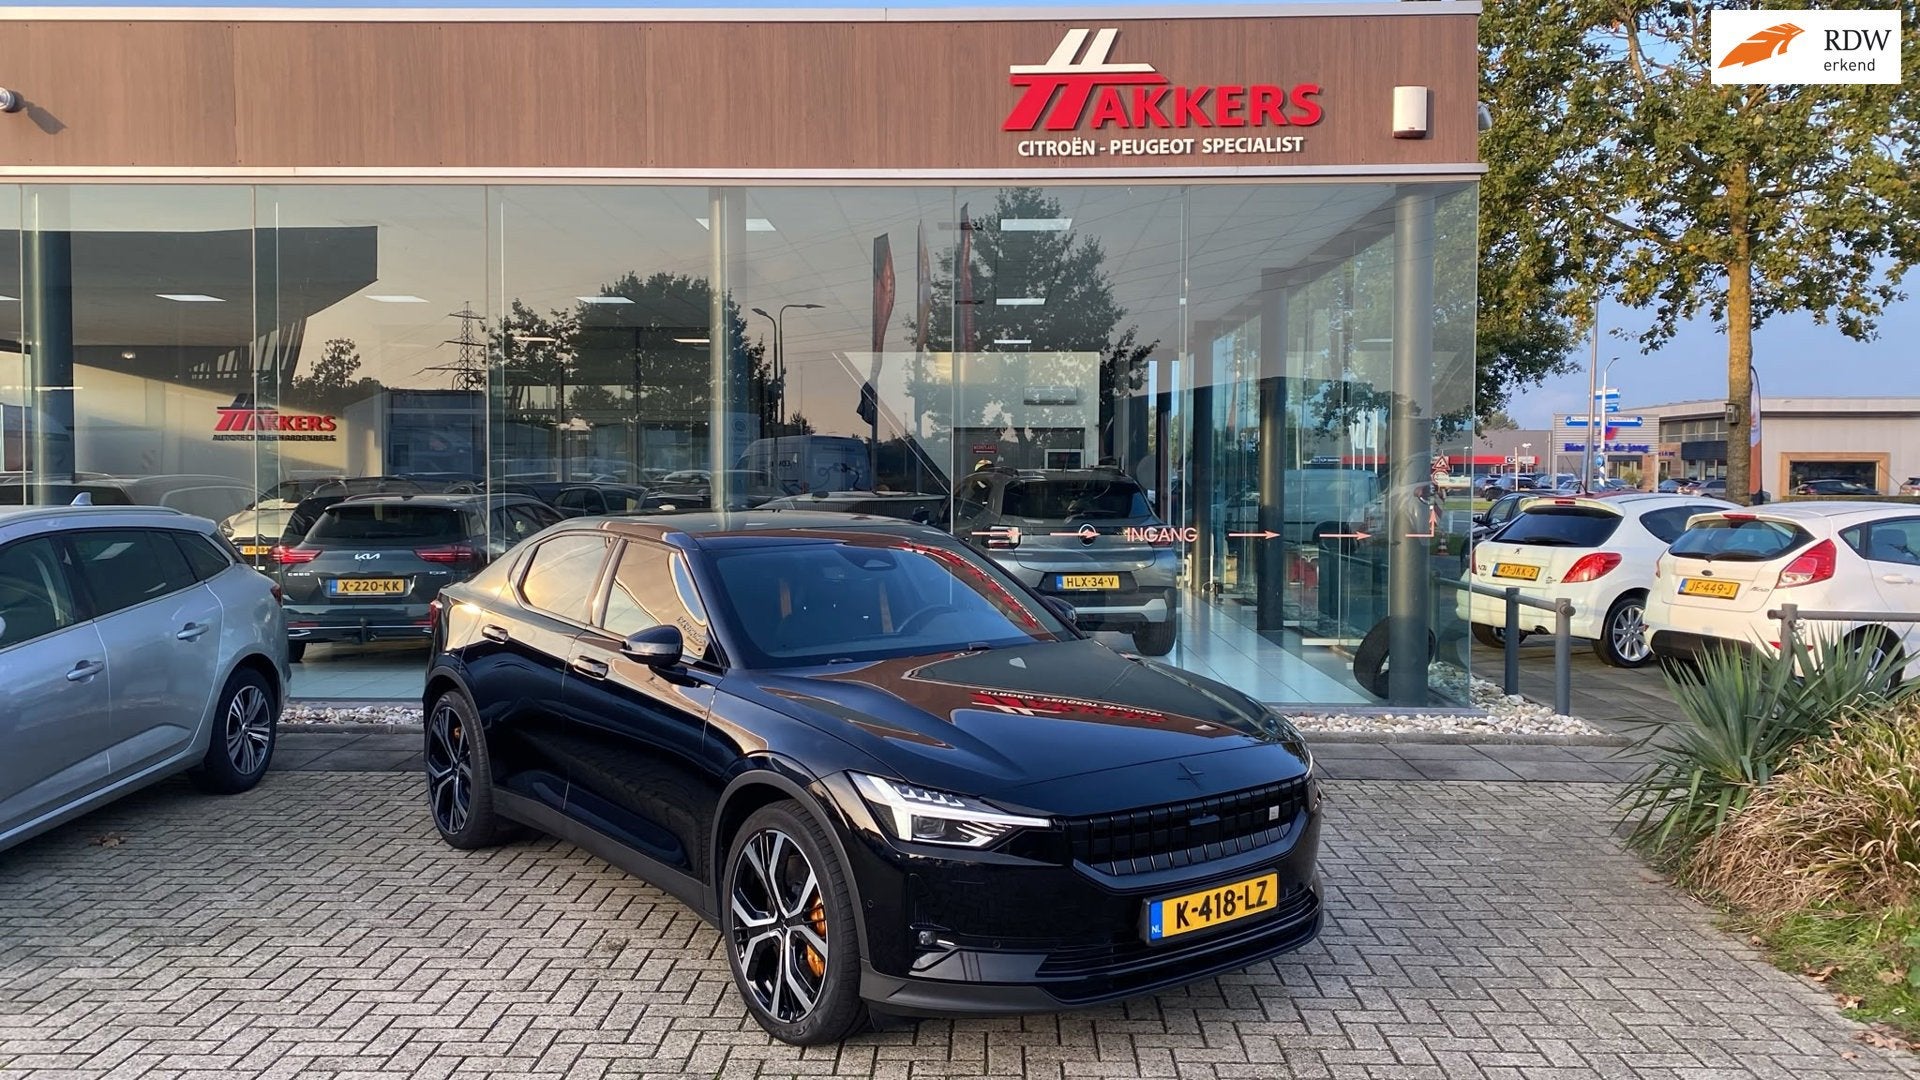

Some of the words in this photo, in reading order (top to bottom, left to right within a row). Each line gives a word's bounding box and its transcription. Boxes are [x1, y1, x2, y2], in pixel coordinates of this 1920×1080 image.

[1001, 28, 1324, 131] HAKKERS
[1017, 136, 1096, 157] CITROËN
[1110, 137, 1195, 156] PEUGEOT
[1202, 136, 1304, 154] SPECIALIST
[1126, 526, 1199, 543] INGANG
[1500, 565, 1536, 578] 47-JKK-2
[341, 581, 400, 592] X-220-KK
[1066, 576, 1115, 588] HLX-34-V
[1688, 581, 1733, 595] JF-449-J
[1176, 880, 1268, 929] K-418-LZ
[1151, 925, 1162, 934] NL
